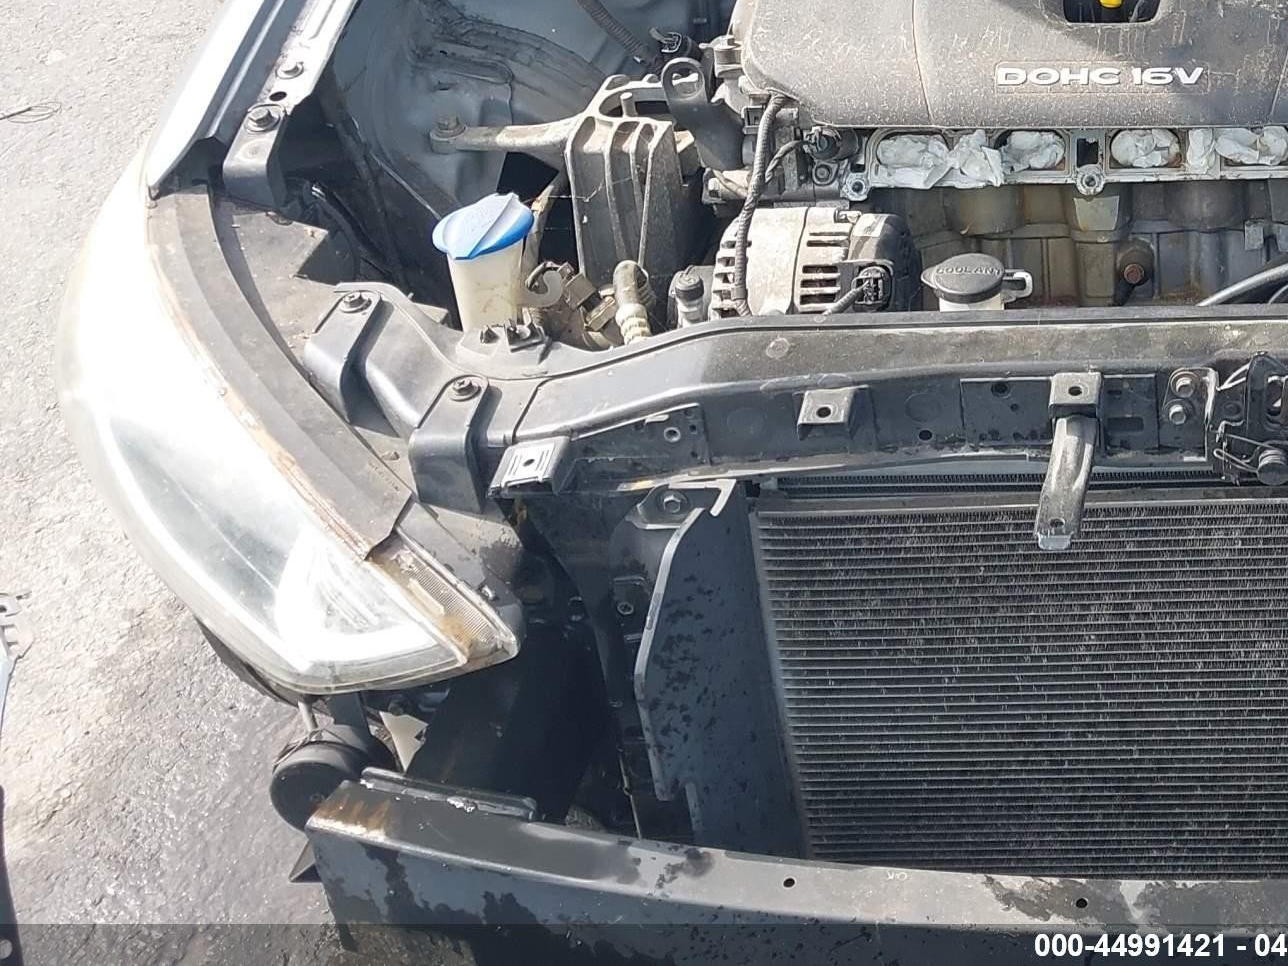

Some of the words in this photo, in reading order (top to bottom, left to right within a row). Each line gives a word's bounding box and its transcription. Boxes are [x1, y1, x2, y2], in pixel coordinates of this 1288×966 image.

[998, 67, 1121, 85] DOHC
[1131, 67, 1204, 85] 16V
[936, 265, 1001, 276] COOLANT
